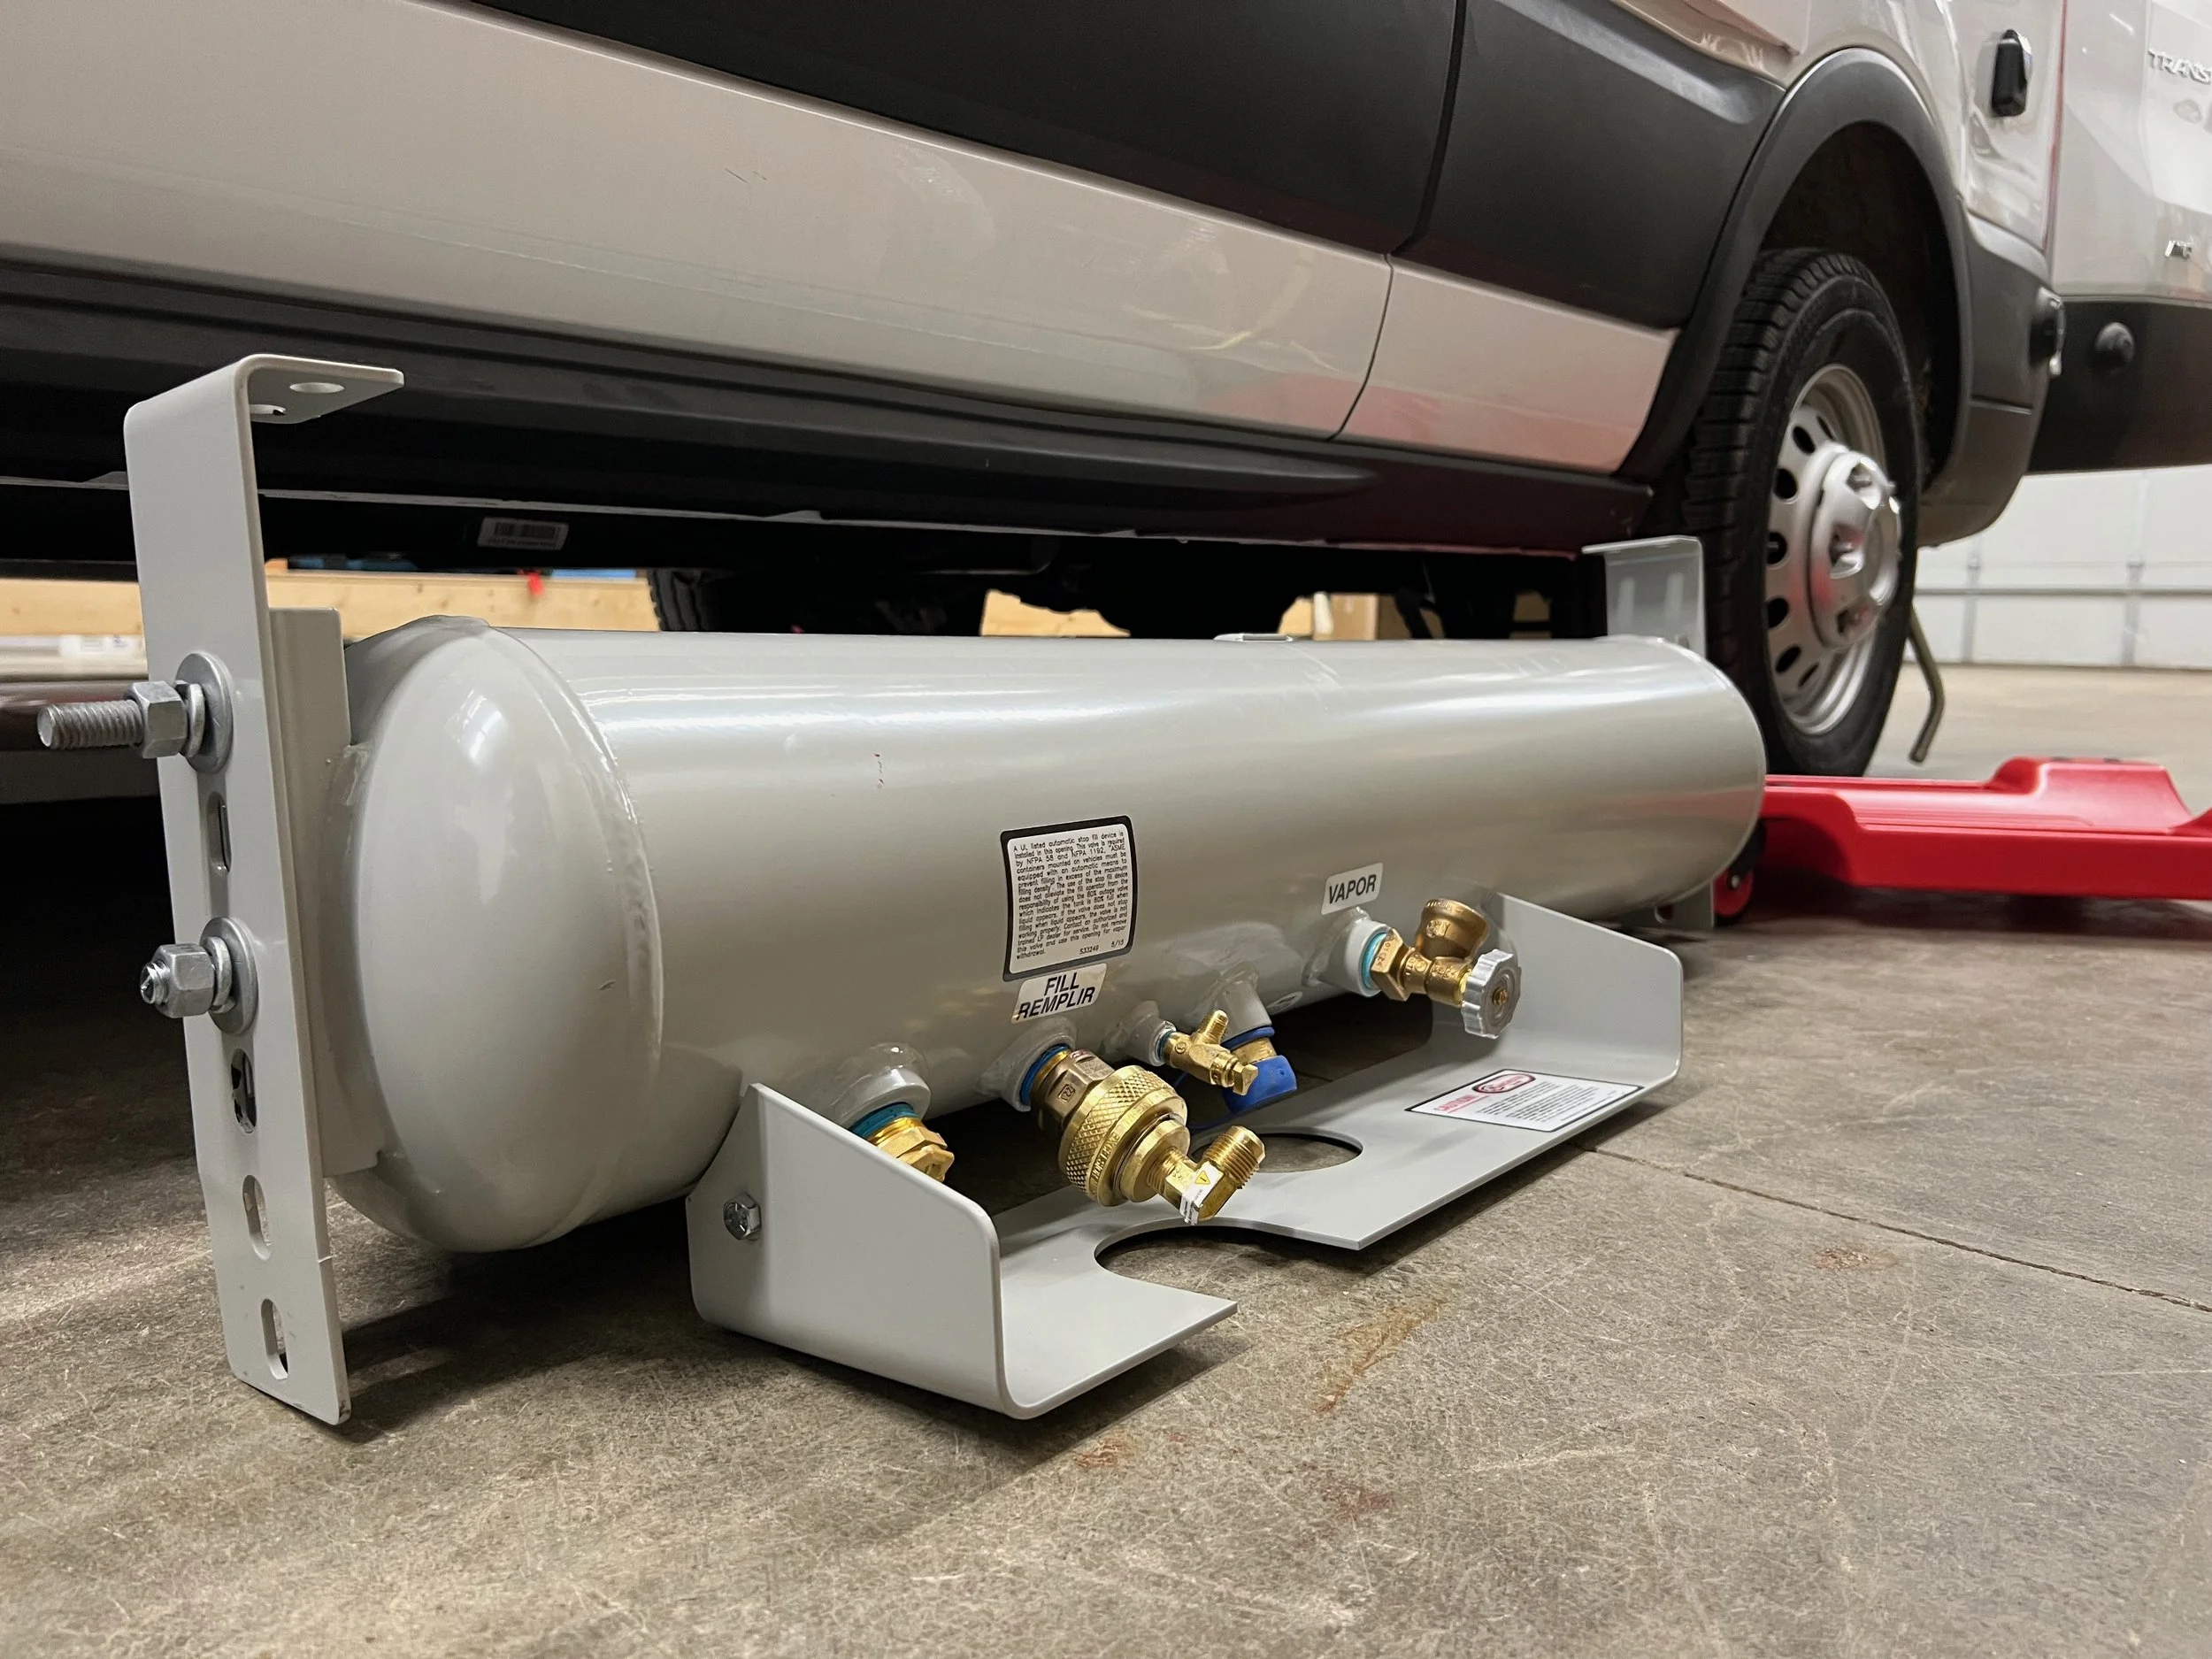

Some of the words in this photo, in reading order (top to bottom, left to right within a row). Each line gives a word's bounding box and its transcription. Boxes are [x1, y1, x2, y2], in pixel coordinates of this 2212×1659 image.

[1108, 837, 1125, 846] required
[1017, 865, 1045, 873] containers
[1048, 860, 1071, 868] mounted
[1018, 871, 1043, 881] equipped
[1072, 863, 1098, 872] automatic
[1018, 879, 1038, 890] prevent
[1086, 883, 1105, 892] operator
[1329, 874, 1376, 904] VAPOR
[1019, 900, 1051, 910] responsibility
[1019, 917, 1033, 926] liquid
[1051, 918, 1064, 926] liquid
[1064, 921, 1082, 929] Contact
[1093, 914, 1117, 923] authorized
[1082, 931, 1101, 939] opening
[1018, 937, 1035, 945] trained
[1044, 972, 1079, 996] FILL
[1016, 987, 1095, 1020] REMPLIR
